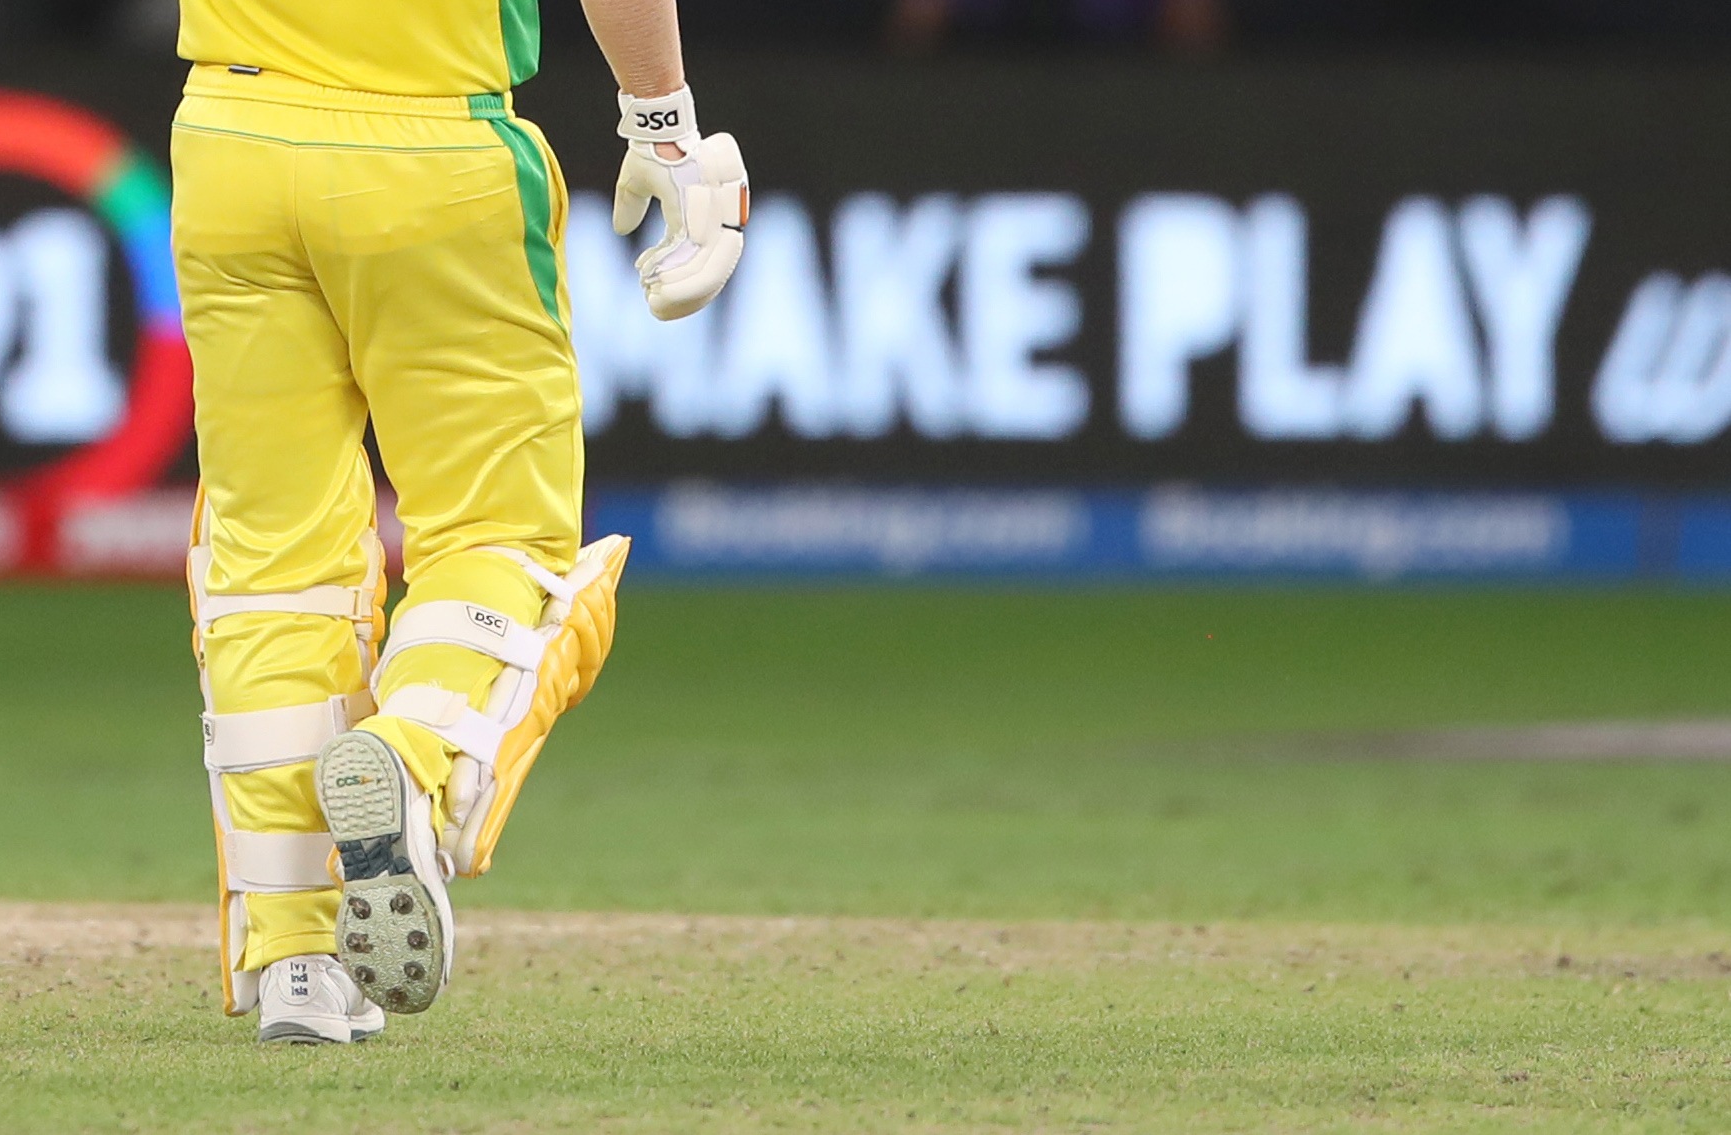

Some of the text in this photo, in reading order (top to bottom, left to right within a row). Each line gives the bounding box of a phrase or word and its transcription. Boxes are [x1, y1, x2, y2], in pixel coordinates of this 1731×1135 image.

[635, 110, 679, 130] DSC
[1115, 192, 1592, 441] PLAY
[474, 612, 504, 629] DSC
[290, 962, 307, 972] Ivy
